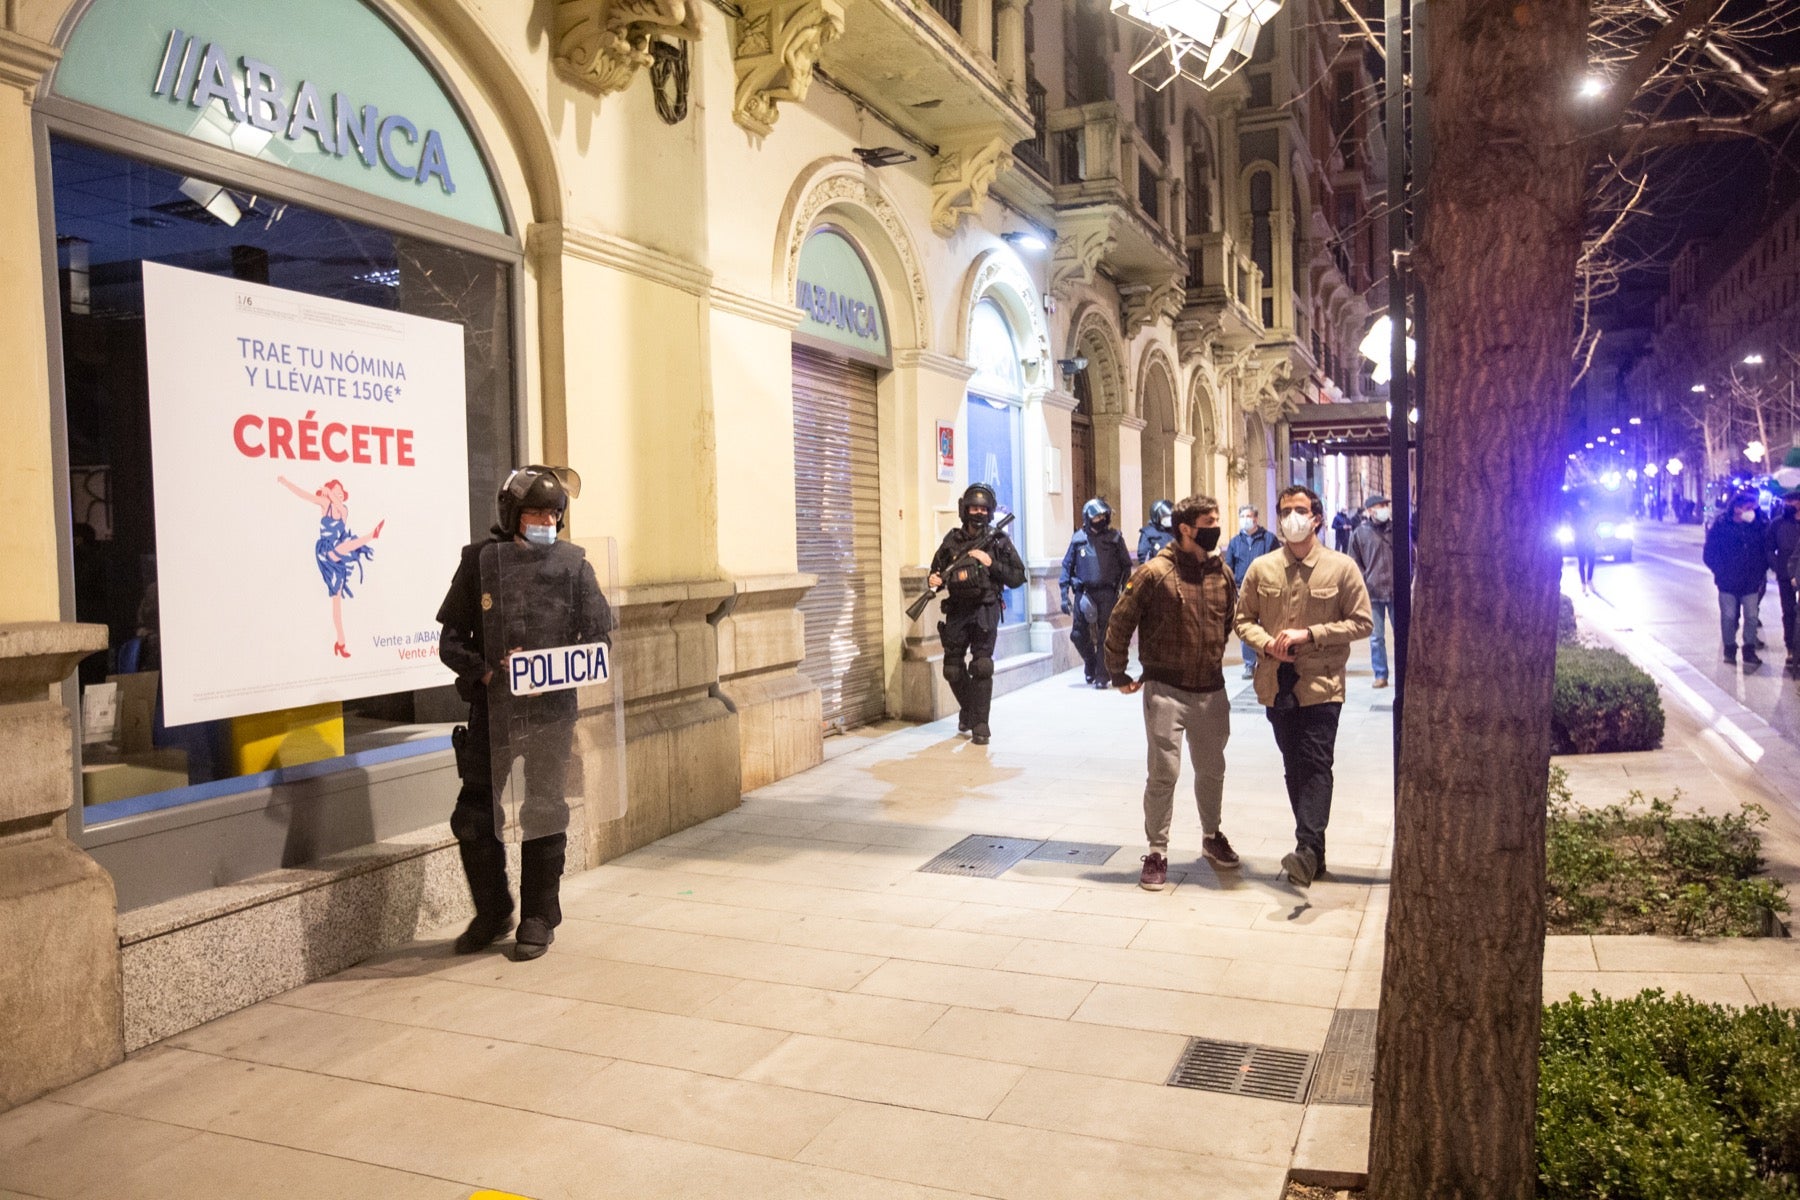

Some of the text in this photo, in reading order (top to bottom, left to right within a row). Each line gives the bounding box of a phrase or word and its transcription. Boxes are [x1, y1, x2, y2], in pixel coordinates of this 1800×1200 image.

[237, 294, 253, 306] 1/6
[237, 337, 406, 380] TRAE TU NÓMINA
[245, 365, 258, 386] Y
[265, 367, 347, 397] LLÉVATE
[233, 410, 416, 466] CRÉCETE
[373, 634, 403, 647] Vente
[405, 635, 411, 644] a
[398, 647, 426, 660] Vente
[512, 647, 608, 690] POLICIA
